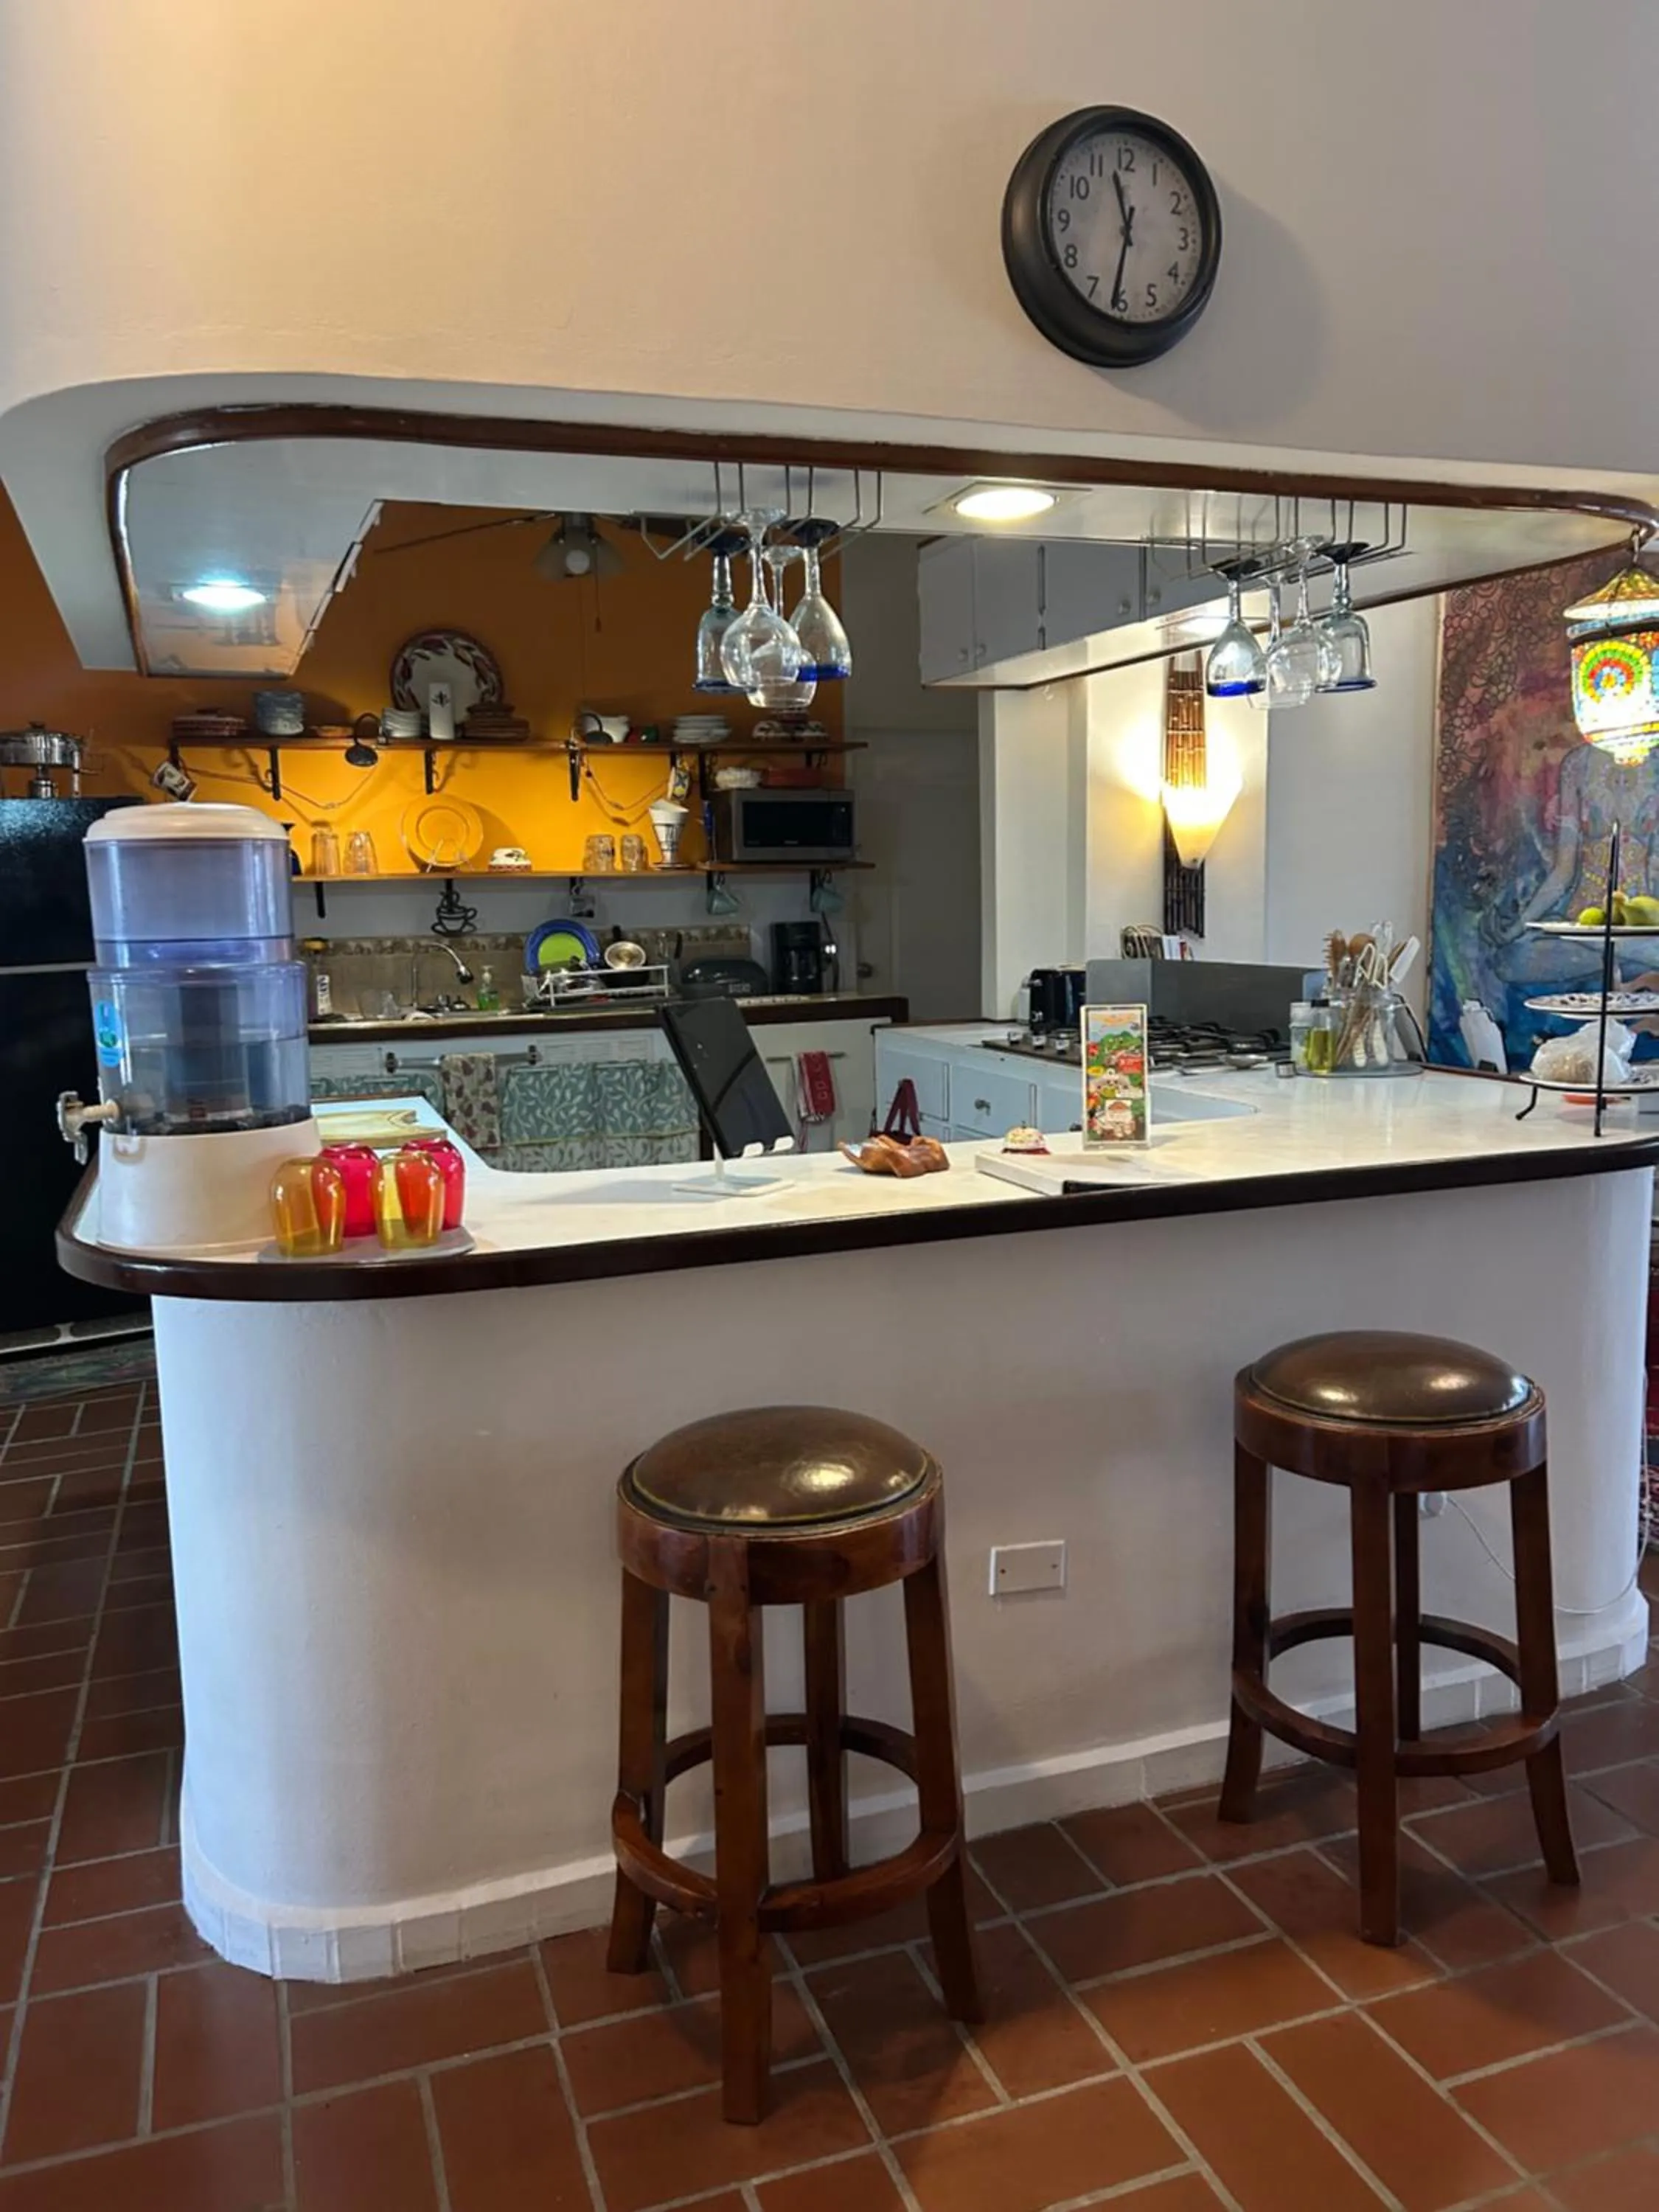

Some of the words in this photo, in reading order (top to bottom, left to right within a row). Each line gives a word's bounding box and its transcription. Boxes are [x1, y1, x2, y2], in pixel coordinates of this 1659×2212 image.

[1090, 153, 1103, 178] 11
[1118, 147, 1135, 173] 12
[1152, 162, 1158, 187] 1
[1069, 174, 1090, 201] 10
[1169, 190, 1182, 216] 2
[1057, 209, 1071, 233] 9
[1177, 227, 1190, 251] 3
[1064, 243, 1078, 268] 8
[1167, 260, 1180, 285] 4
[1086, 275, 1100, 299] 7
[1145, 283, 1158, 307] 5
[1114, 289, 1129, 313] 6
